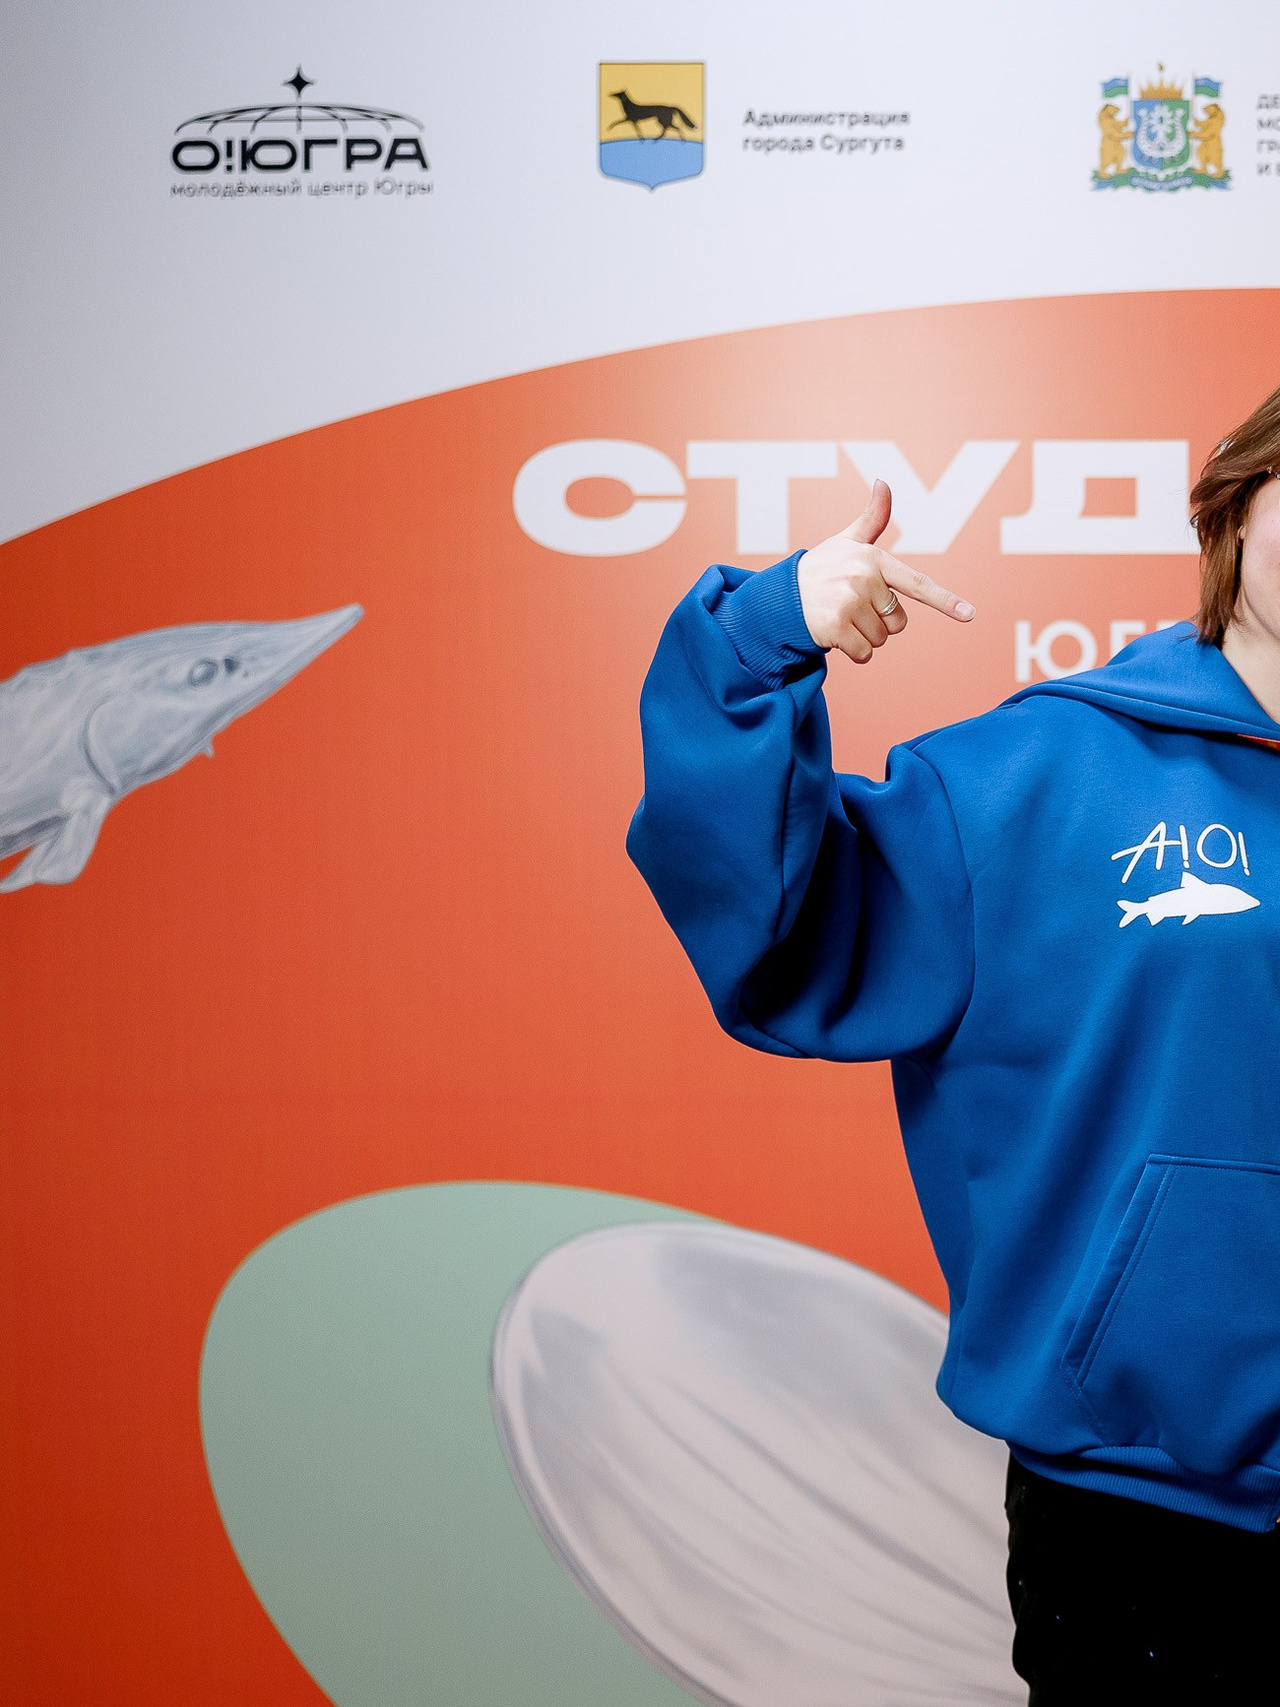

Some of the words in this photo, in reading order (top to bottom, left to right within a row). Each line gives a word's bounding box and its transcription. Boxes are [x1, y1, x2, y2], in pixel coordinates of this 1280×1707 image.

[743, 108, 910, 128] Администрация
[743, 136, 814, 153] города
[820, 134, 905, 155] Сургута
[1257, 162, 1271, 176] И
[307, 181, 368, 199] центр
[374, 177, 434, 199] Югры
